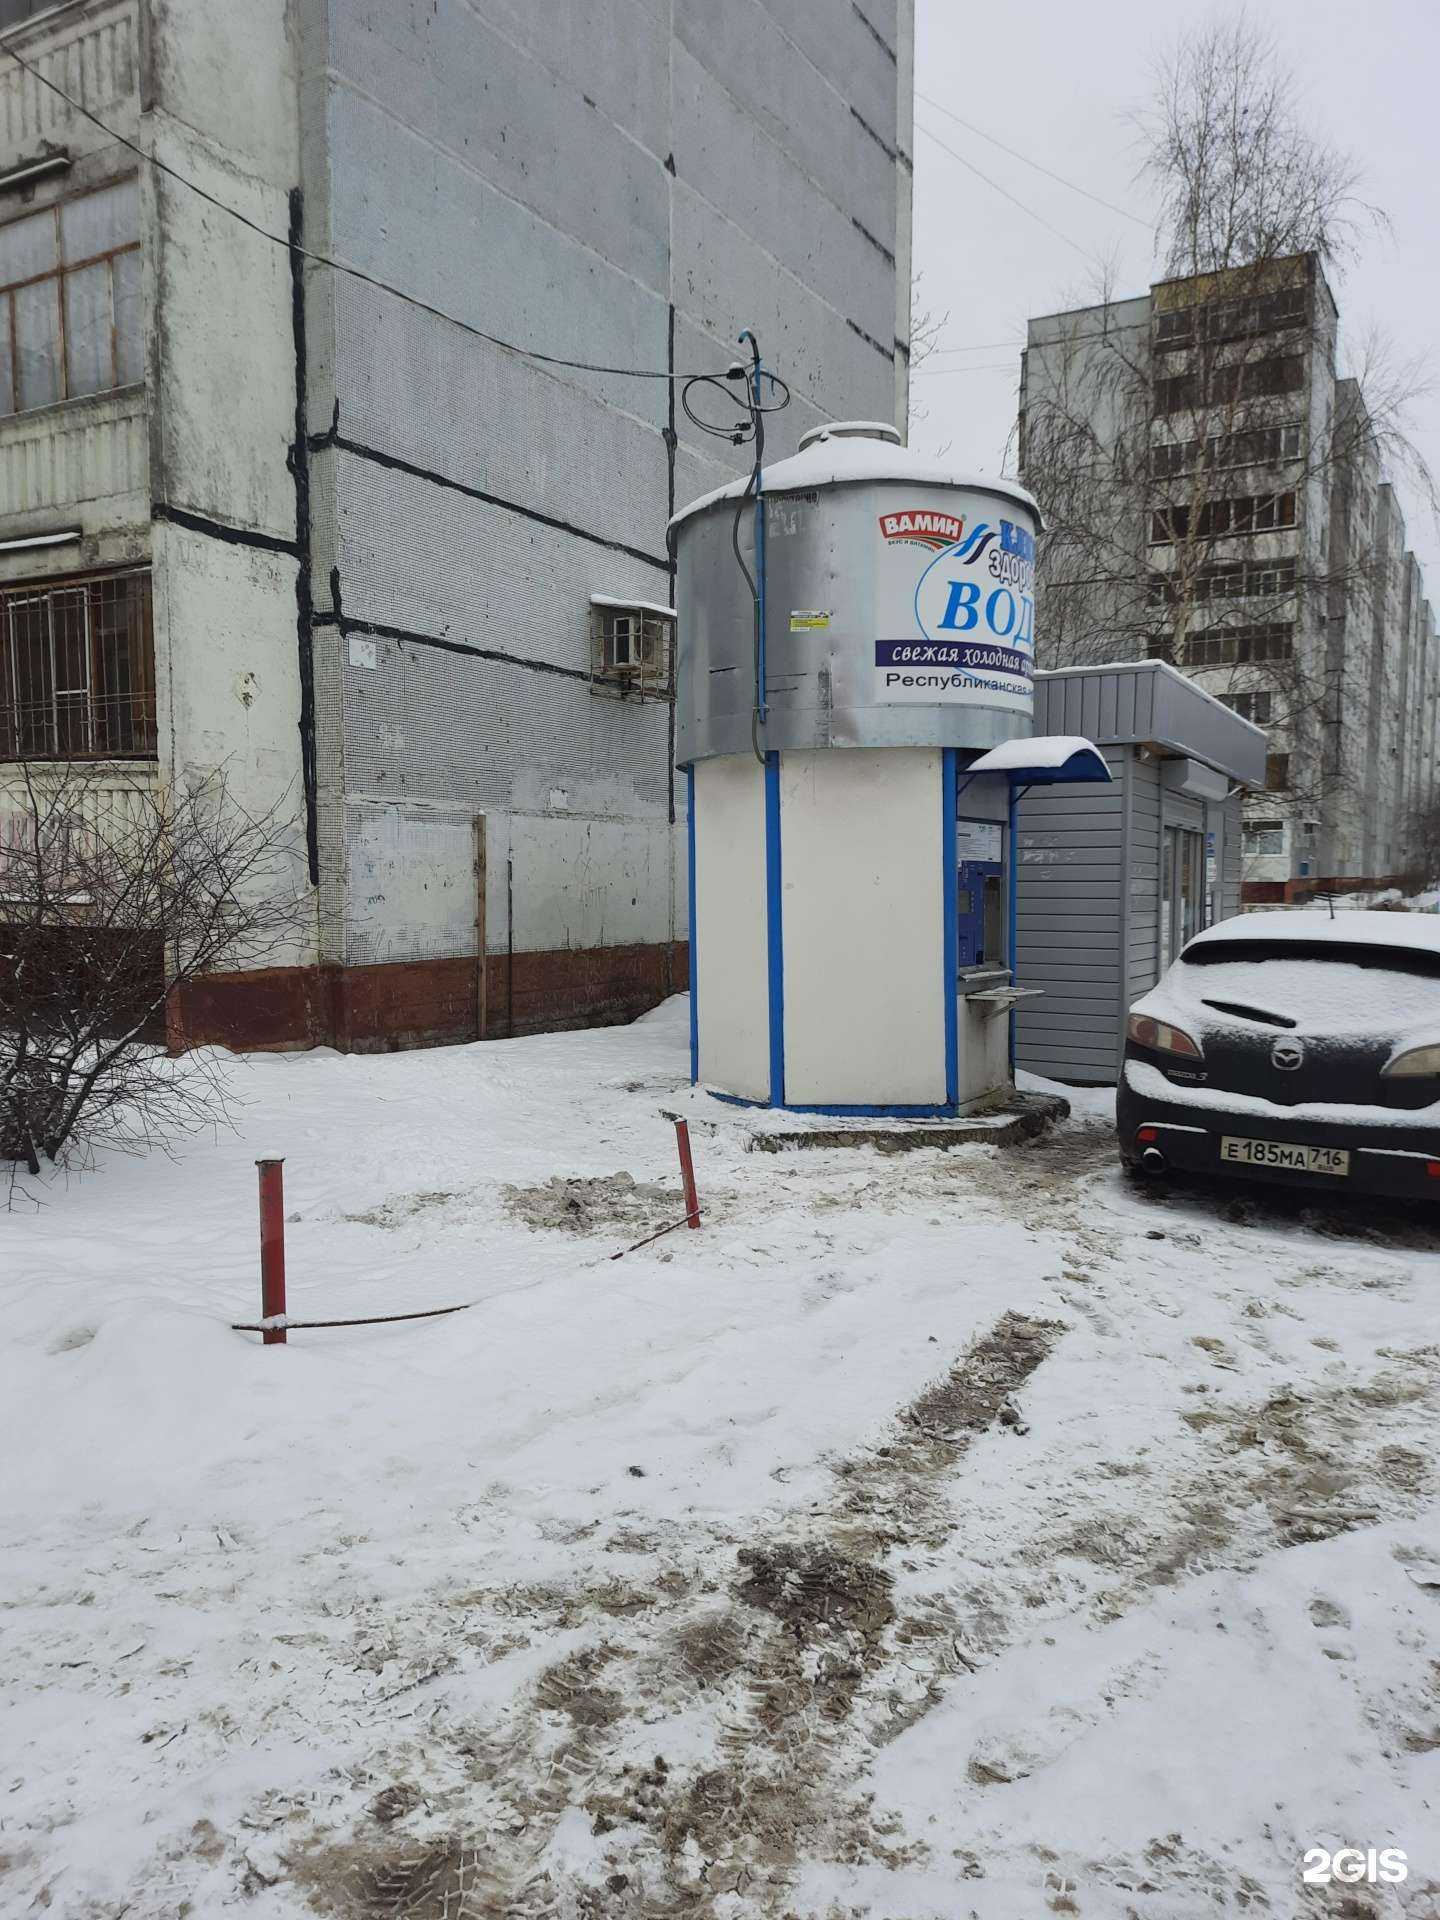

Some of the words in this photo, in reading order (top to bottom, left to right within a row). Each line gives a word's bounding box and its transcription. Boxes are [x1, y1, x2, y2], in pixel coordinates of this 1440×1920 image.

[885, 514, 959, 537] ВАМИН
[892, 646, 959, 665] свежая
[963, 648, 1020, 671] холодная
[1311, 1148, 1342, 1166] 716
